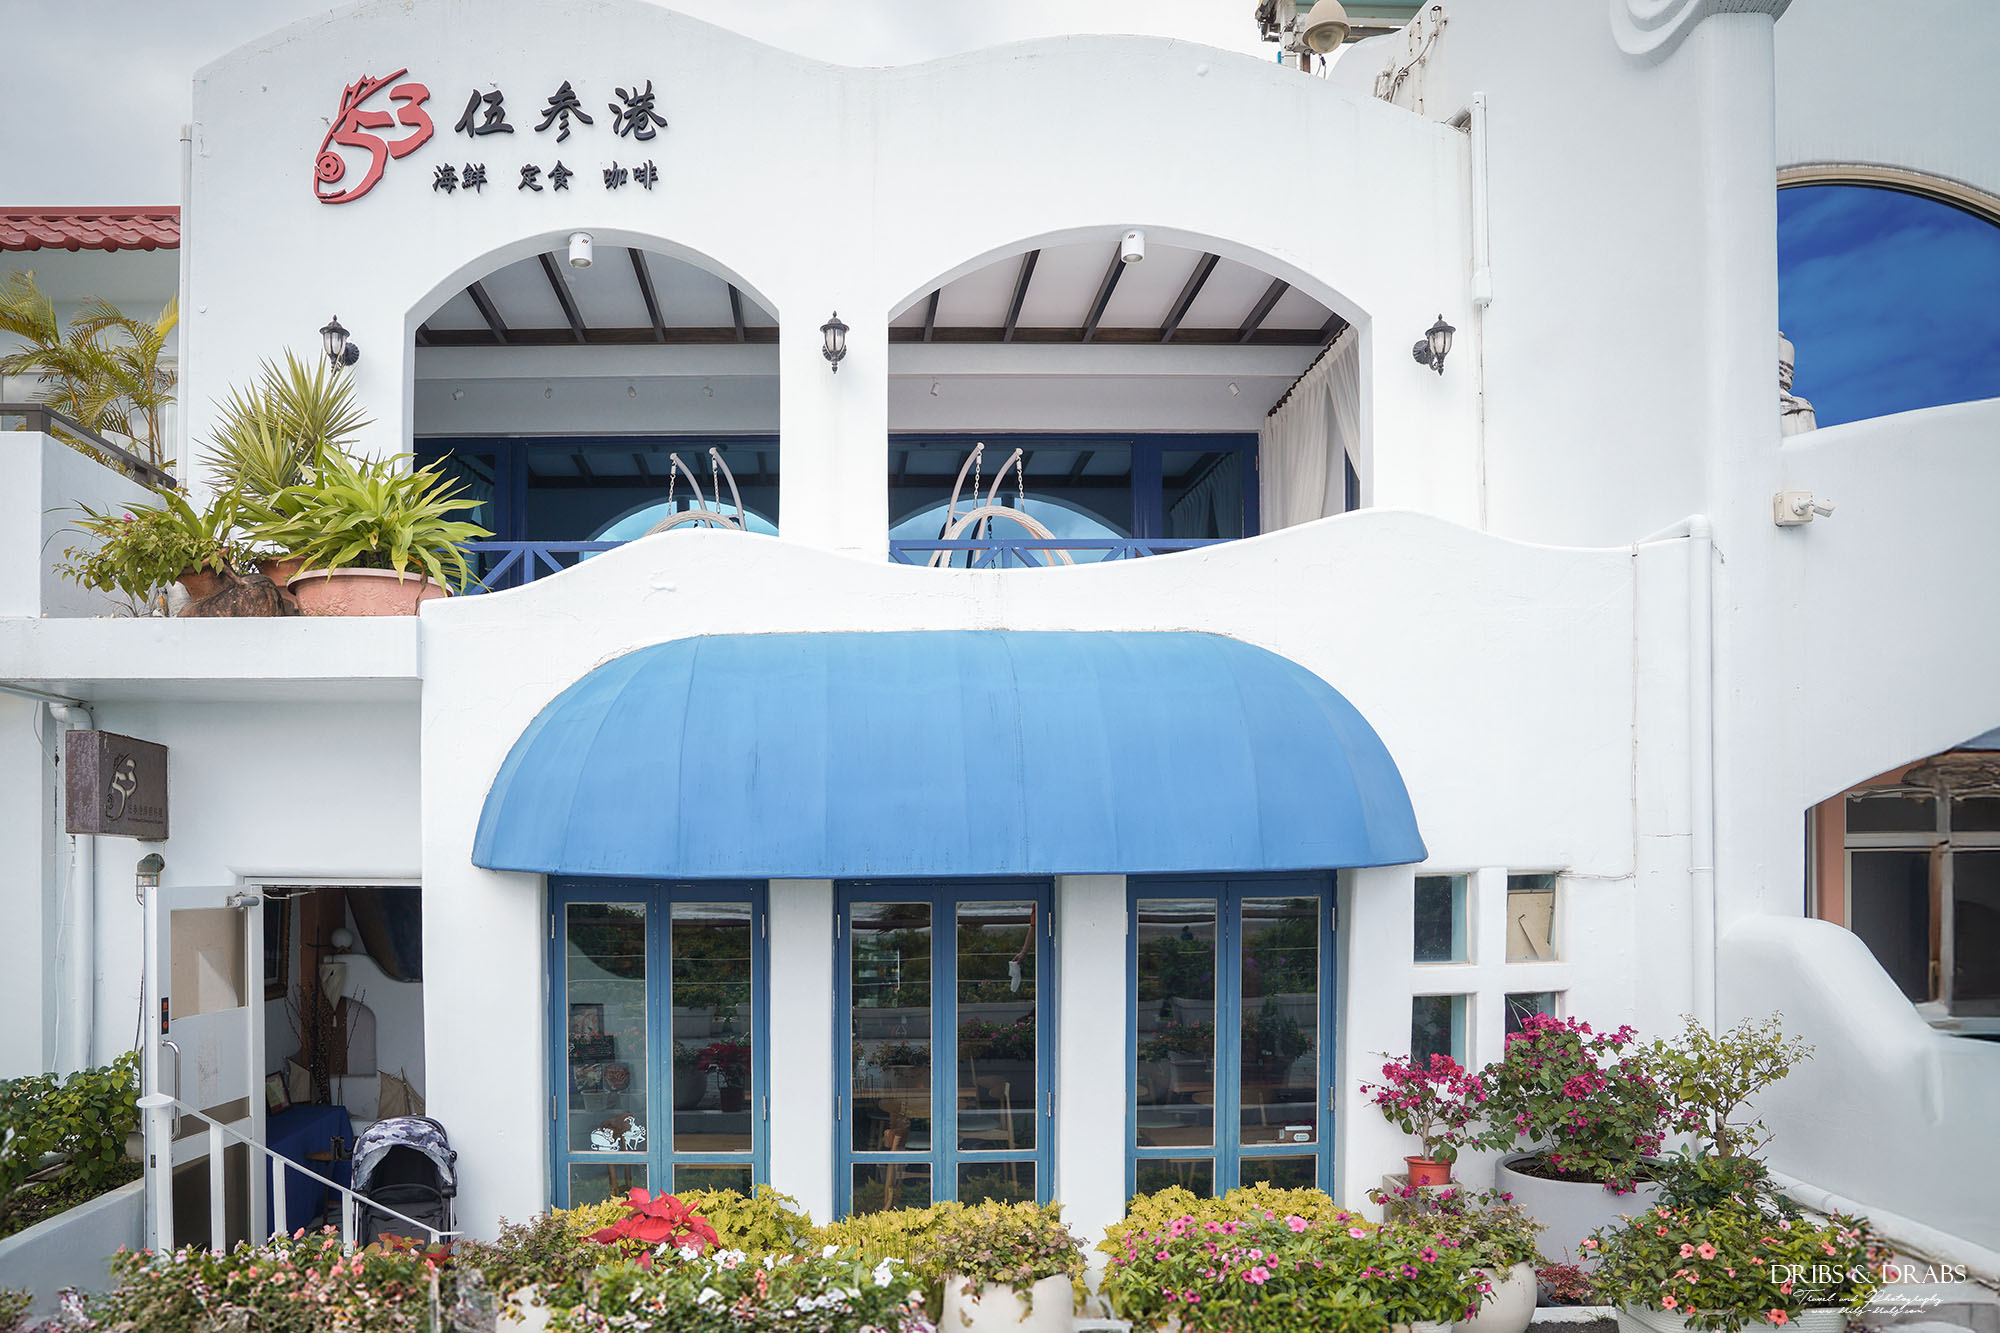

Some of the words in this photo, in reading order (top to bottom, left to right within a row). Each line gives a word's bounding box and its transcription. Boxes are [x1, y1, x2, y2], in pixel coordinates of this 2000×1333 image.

[432, 162, 488, 194] 海鮮
[518, 160, 573, 192] 定食
[602, 159, 659, 191] 咖啡
